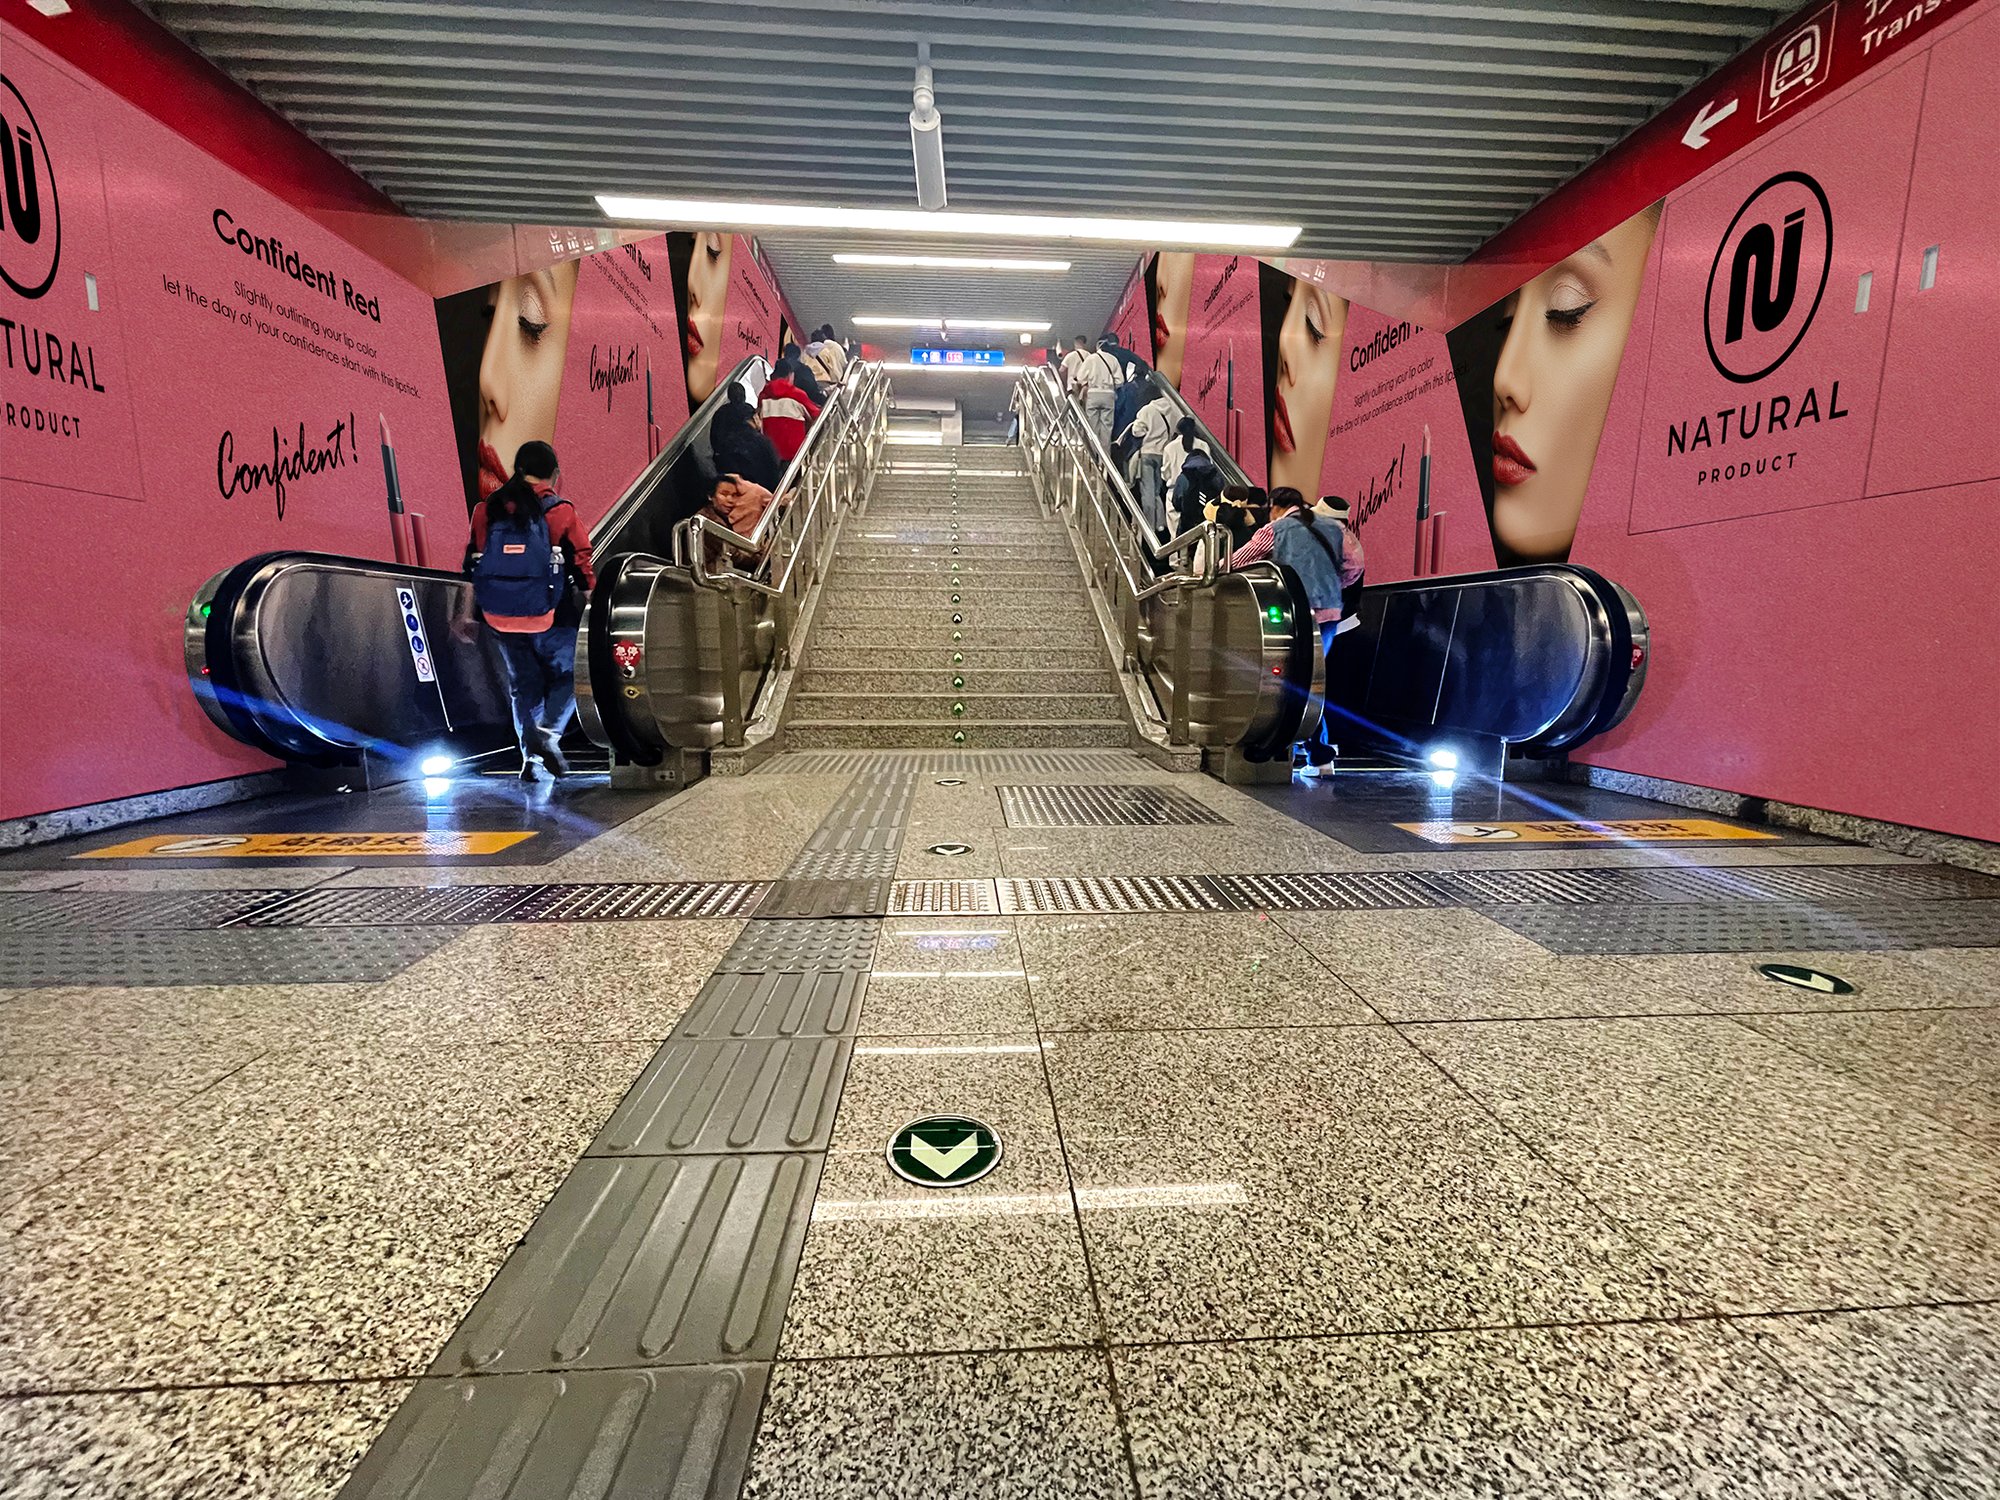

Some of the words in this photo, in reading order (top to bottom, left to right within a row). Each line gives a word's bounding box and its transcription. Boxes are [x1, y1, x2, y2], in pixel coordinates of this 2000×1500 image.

[212, 208, 337, 300] Confident
[342, 278, 381, 323] Red
[162, 273, 181, 297] let
[185, 284, 208, 308] the
[211, 298, 237, 323] day
[240, 312, 252, 327] of
[254, 318, 280, 339] your
[282, 331, 340, 364] confidence
[341, 355, 361, 373] start
[361, 365, 380, 382] with
[380, 370, 394, 388] this
[234, 280, 273, 314] Slightly
[276, 304, 320, 336] outlining
[322, 325, 342, 343] your
[343, 331, 355, 351] lip
[355, 342, 378, 359] color
[590, 342, 639, 413] Confident!
[0, 402, 80, 438] RODUCT
[1667, 380, 1849, 457] NATURAL
[217, 411, 358, 521] Confident!
[1697, 452, 1797, 486] PRODUCT
